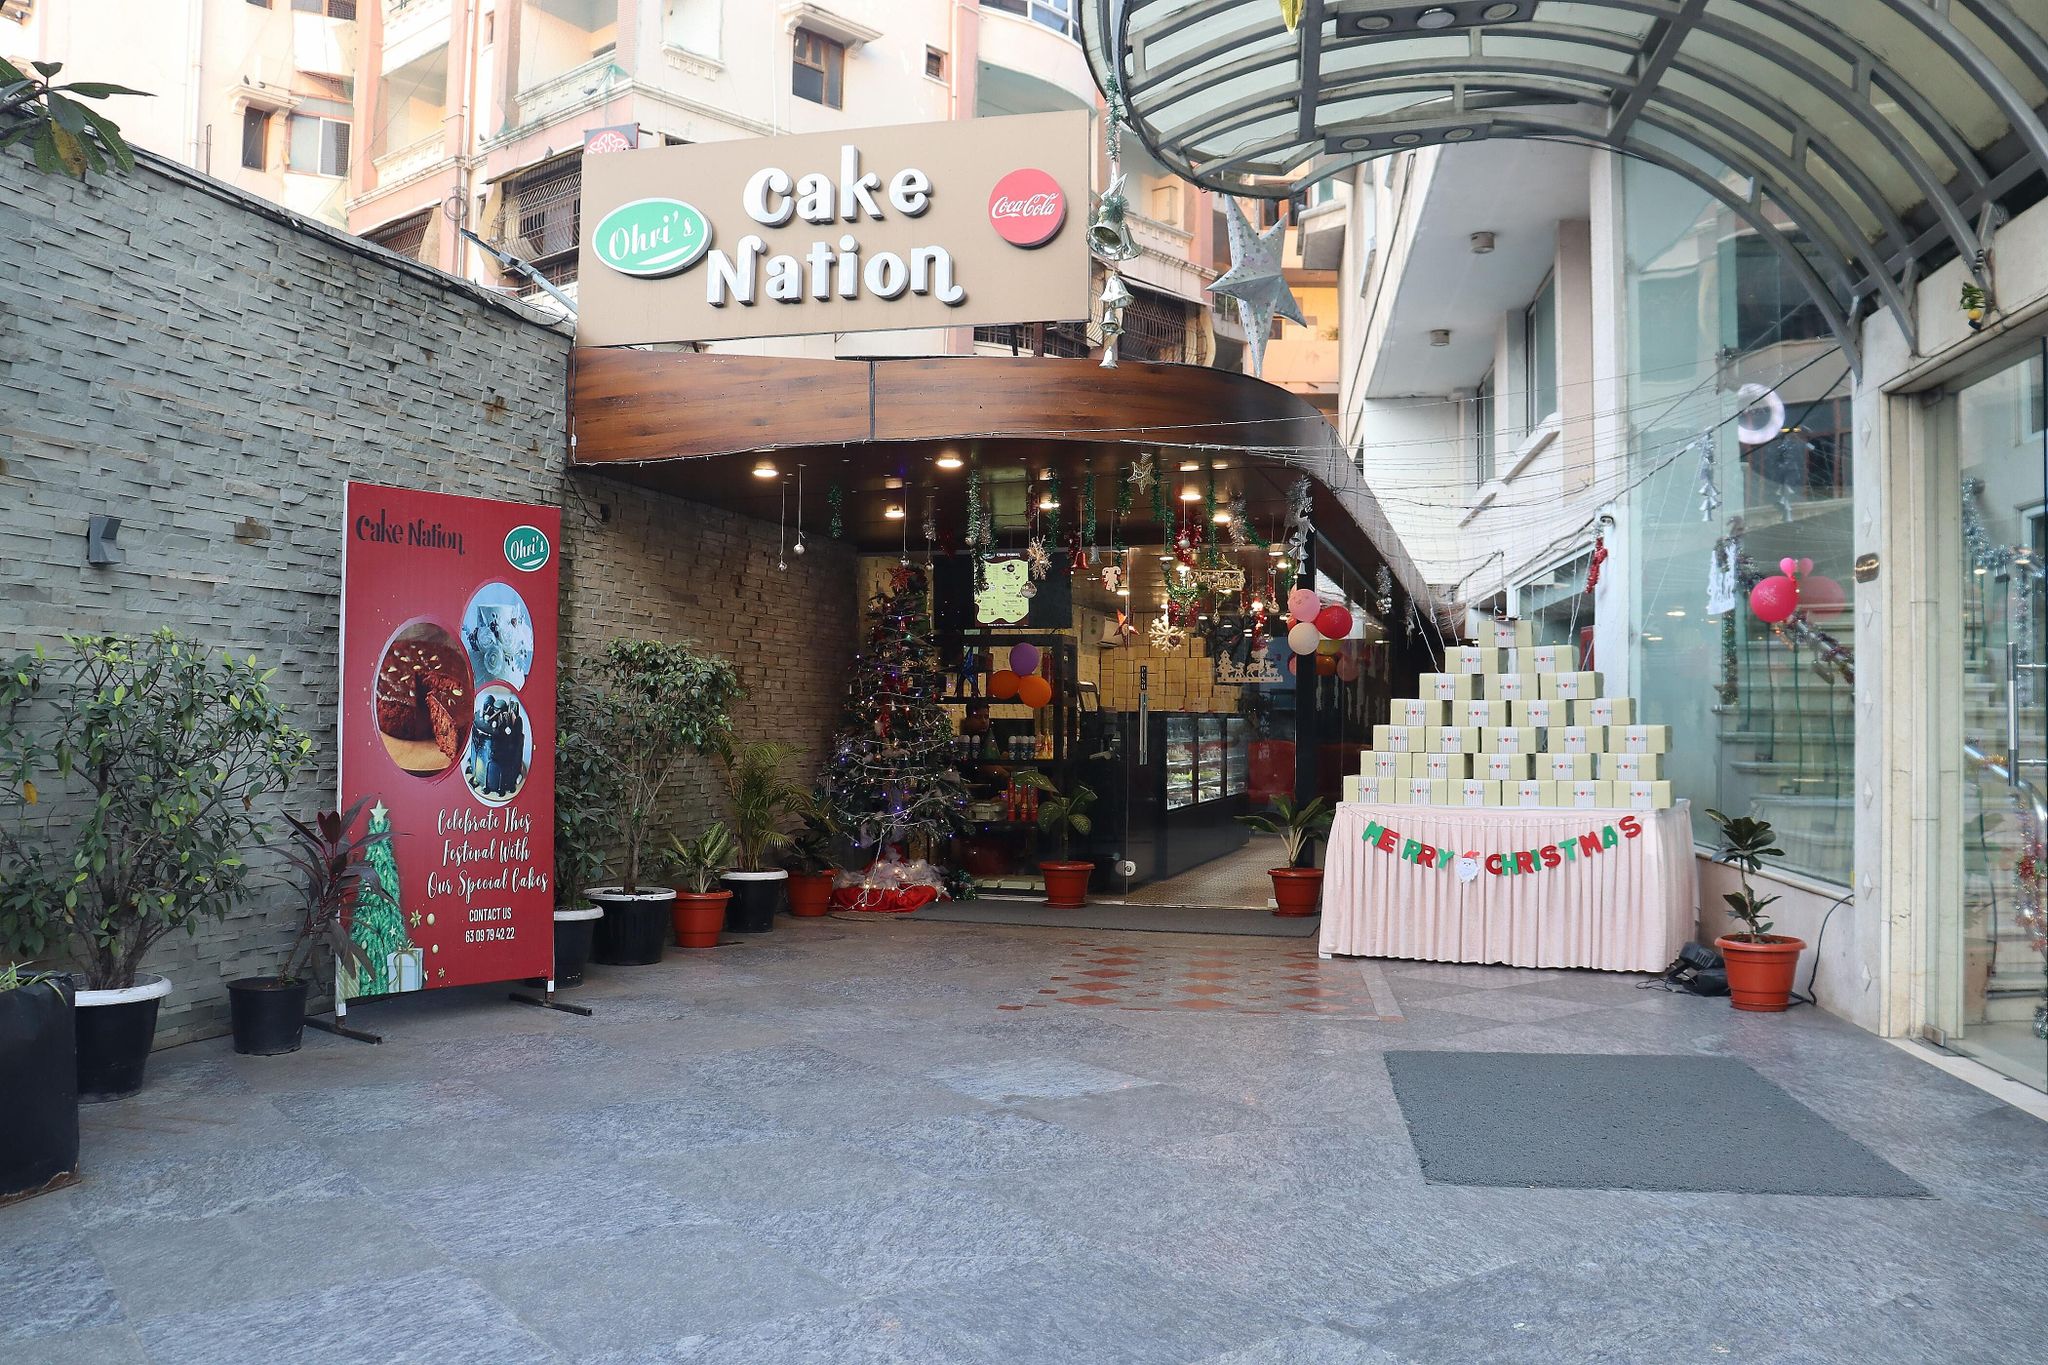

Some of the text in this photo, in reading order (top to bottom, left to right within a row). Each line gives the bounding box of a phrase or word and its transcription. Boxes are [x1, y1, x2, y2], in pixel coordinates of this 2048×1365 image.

[743, 145, 932, 228] Cake
[608, 209, 696, 261] Ohri's
[706, 234, 966, 306] Nation
[355, 508, 466, 556] Cake Nation
[510, 534, 546, 561] Ohri's
[437, 806, 533, 836] Celebrate This
[442, 835, 531, 867] Festival With
[1361, 814, 1643, 877] MERRY CHRISTMAS
[427, 866, 549, 905] Our Special Cakes
[469, 906, 512, 922] CONTACT US
[465, 926, 515, 943] 63 09 79 42 22
